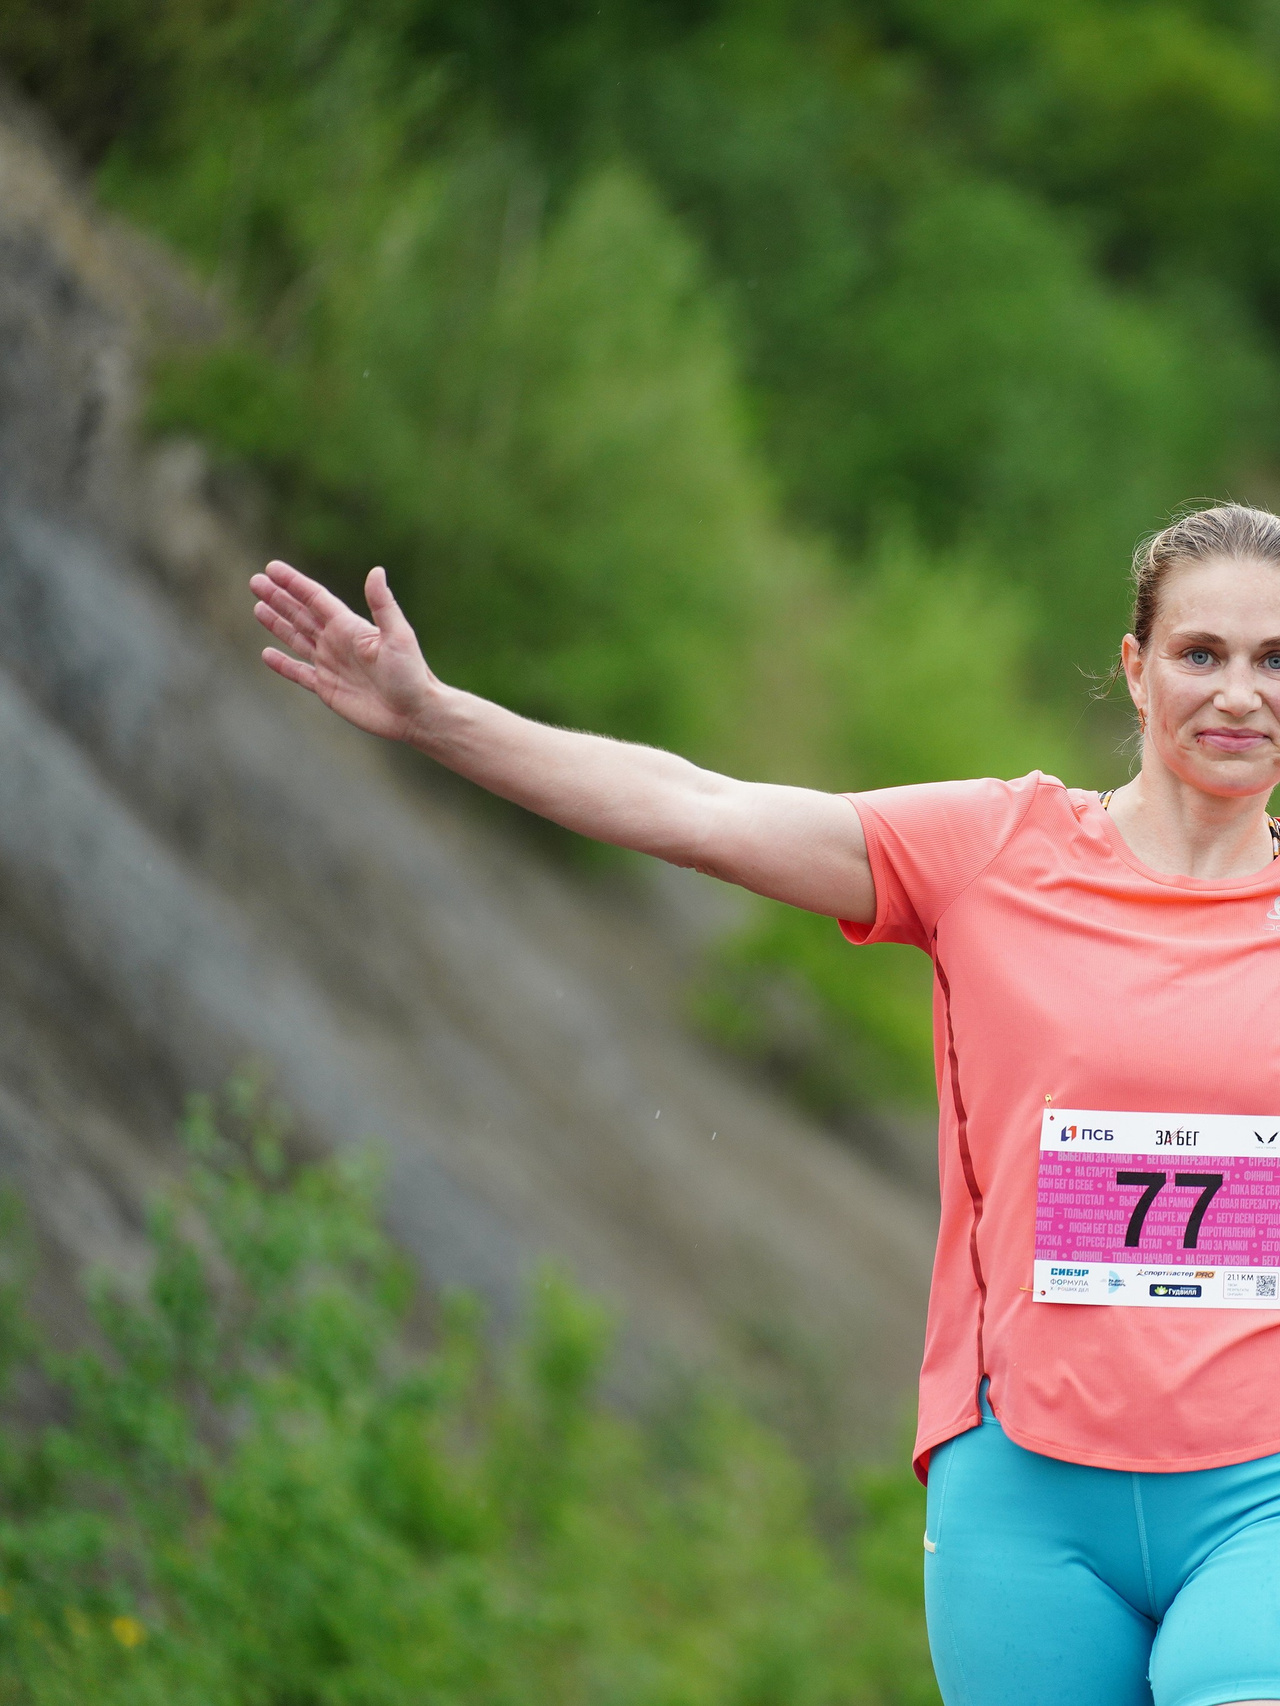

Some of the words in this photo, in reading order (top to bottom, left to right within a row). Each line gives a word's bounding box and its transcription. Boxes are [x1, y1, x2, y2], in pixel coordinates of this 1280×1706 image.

[1082, 1129, 1114, 1140] ПСБ
[1095, 1153, 1105, 1163] ЗА
[1106, 1154, 1132, 1164] РАМКИ
[1075, 1166, 1085, 1177] НА
[1086, 1167, 1114, 1178] СТАРТЕ
[1244, 1171, 1273, 1182] ФИНИШ
[1055, 1179, 1068, 1189] БЕГ
[1069, 1180, 1076, 1190] В
[1079, 1180, 1093, 1191] СЕБЕ
[1230, 1185, 1250, 1195] ПОКА
[1251, 1185, 1264, 1195] ВСЕ
[1049, 1193, 1074, 1205] ДАВНО
[1075, 1194, 1104, 1205] ОТСТАЛ
[1158, 1197, 1167, 1207] ЗА
[1169, 1197, 1194, 1209] РАМКИ
[1064, 1208, 1093, 1220] ТОЛЬКО
[1094, 1209, 1124, 1221] НАЧАЛО
[1117, 1172, 1222, 1248] 77
[1149, 1212, 1176, 1222] СТАРТЕ
[1217, 1213, 1233, 1223] БЕГУ
[1235, 1214, 1255, 1224] ВСЕМ
[1069, 1222, 1092, 1233] ЛЮБИ
[1093, 1223, 1106, 1234] БЕГ
[1108, 1224, 1114, 1234] В
[1199, 1226, 1256, 1238] ОПРОТИВЛЕНИЙ
[1076, 1236, 1105, 1247] СТРЕСС
[1214, 1240, 1223, 1251] ЗА
[1224, 1241, 1248, 1251] РАМКИ
[1072, 1250, 1102, 1261] ФИНИШ
[1112, 1252, 1142, 1263] ТОЛЬКО
[1144, 1253, 1173, 1264] НАЧАЛО
[1185, 1254, 1195, 1264] НА
[1196, 1255, 1222, 1265] СТАРТЕ
[1223, 1255, 1250, 1266] ЖИЗНИ
[1262, 1256, 1279, 1266] БЕГУ
[1051, 1268, 1089, 1277] СИБУР
